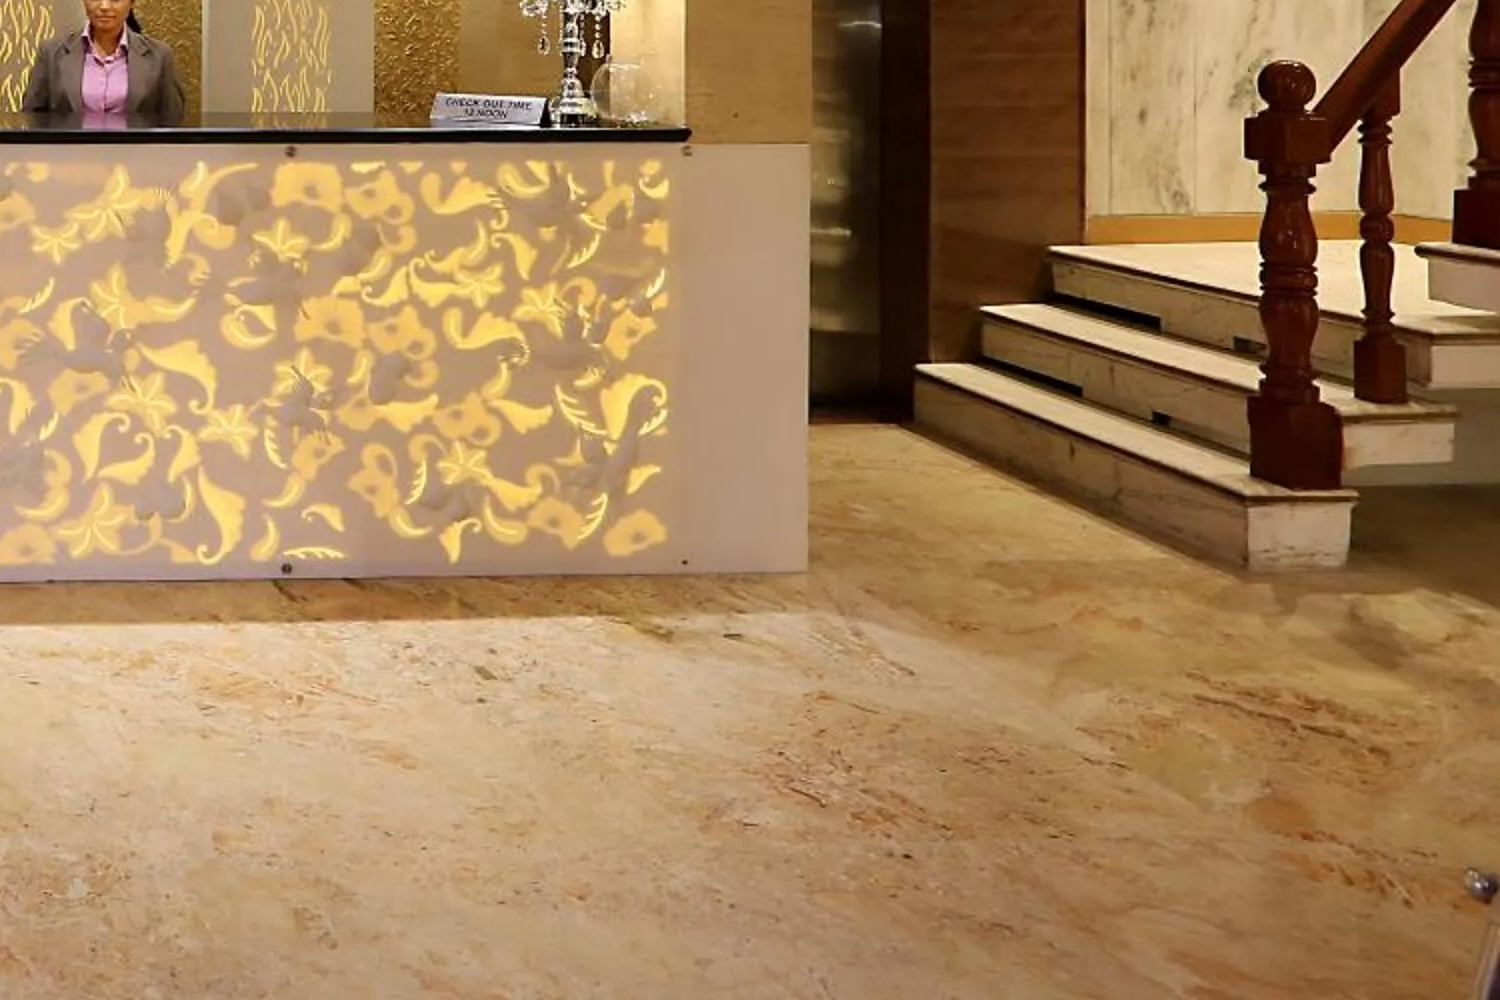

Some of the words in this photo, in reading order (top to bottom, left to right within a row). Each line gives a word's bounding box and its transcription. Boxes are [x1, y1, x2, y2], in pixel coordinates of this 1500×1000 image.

[445, 97, 479, 108] CHECK
[483, 99, 504, 109] OUT
[507, 100, 533, 111] TIME
[476, 109, 508, 119] NOON
